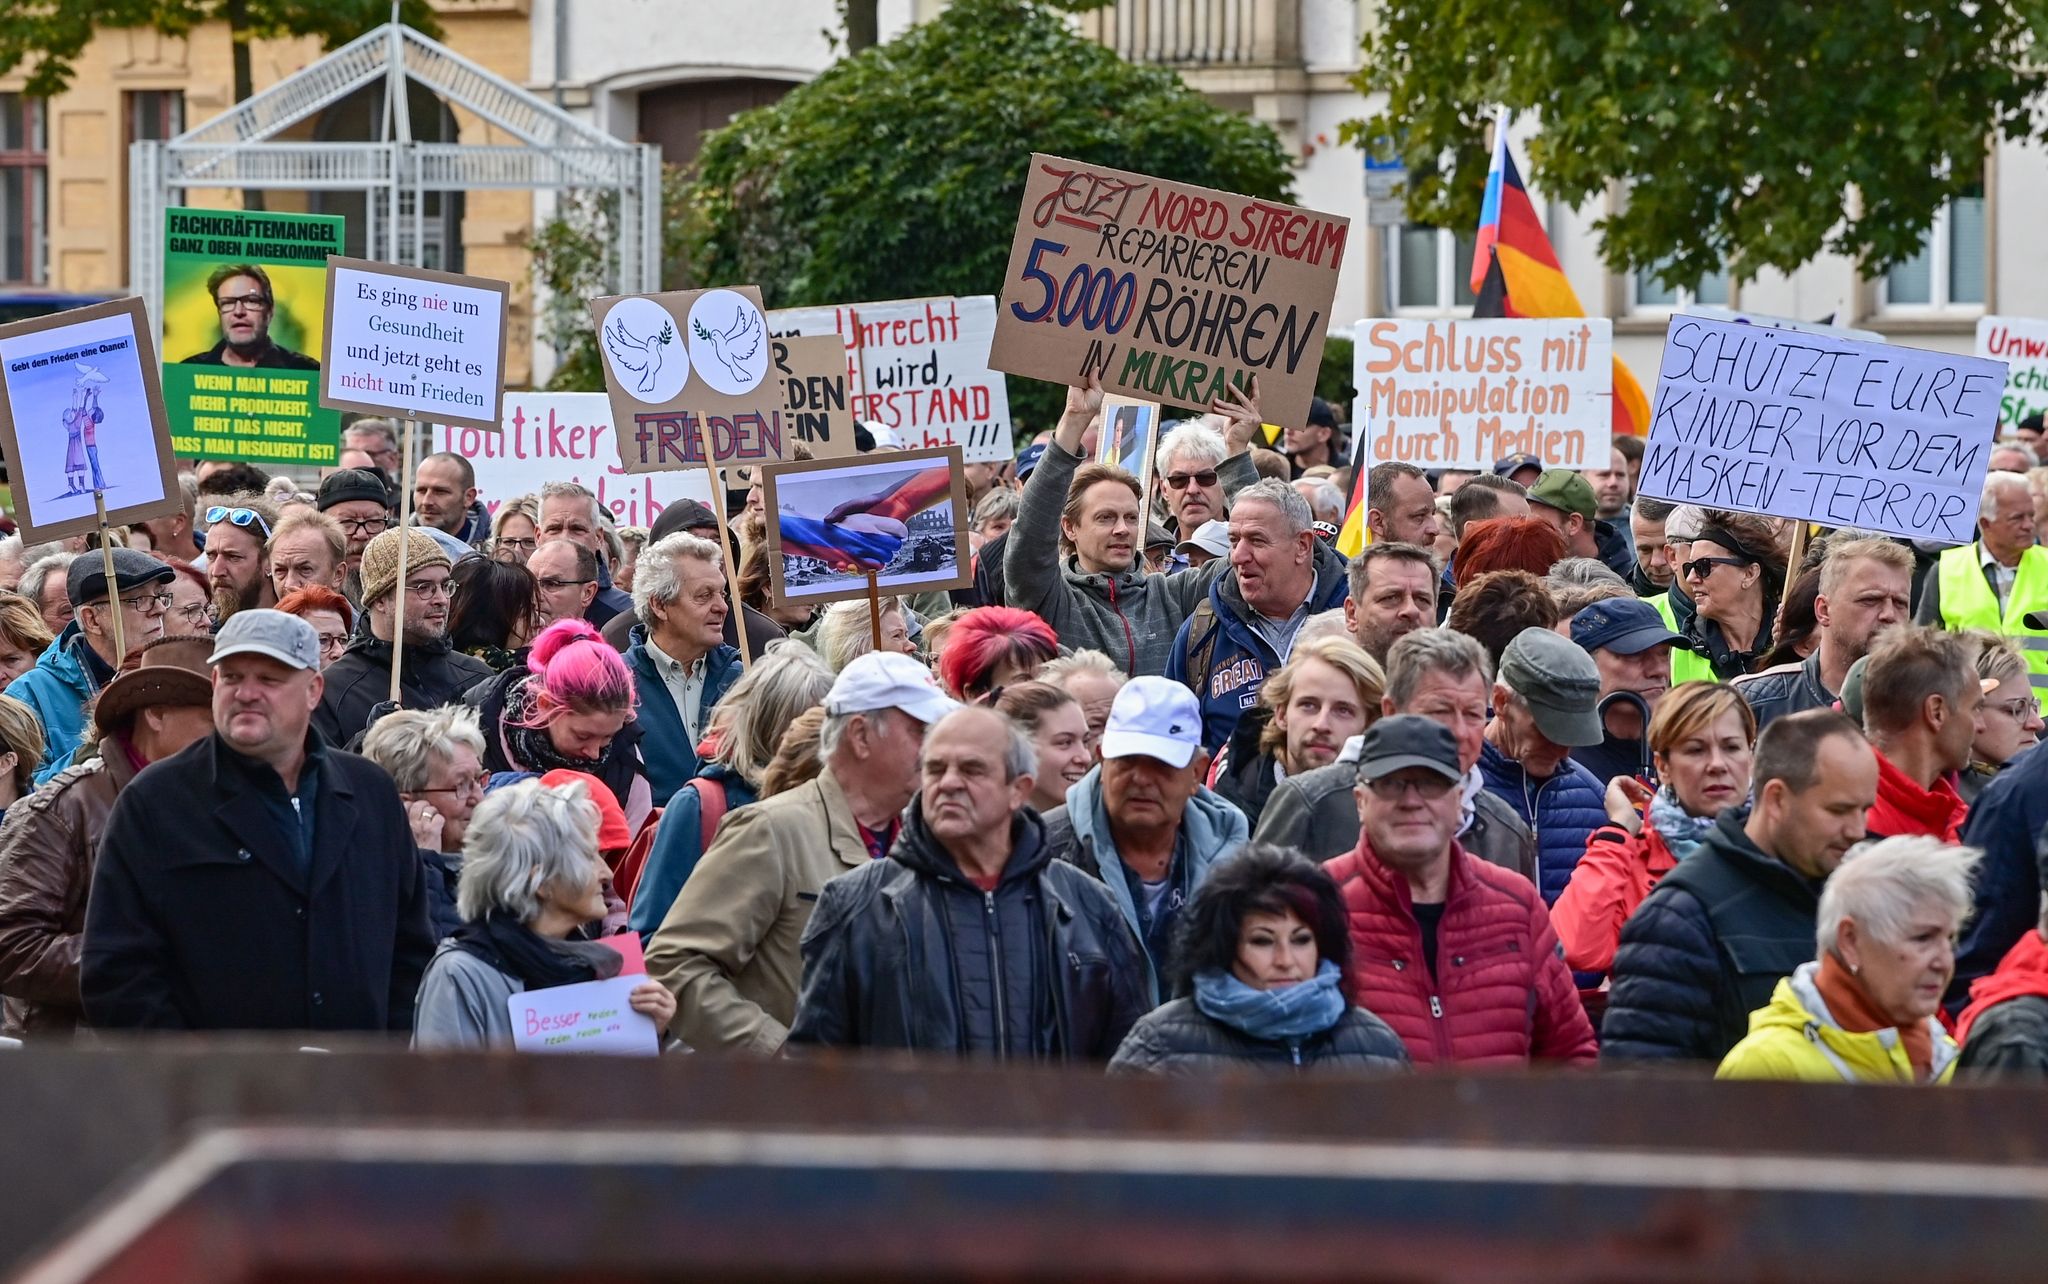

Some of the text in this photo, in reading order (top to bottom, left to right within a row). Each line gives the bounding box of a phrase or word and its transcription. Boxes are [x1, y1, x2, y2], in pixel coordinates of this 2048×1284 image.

[170, 215, 336, 242] FACHKRÄFTEMANGEL
[1032, 163, 1347, 270] JETZT NORD STREAM
[170, 238, 203, 254] GANZ
[208, 240, 242, 256] OBEN
[1097, 223, 1270, 295] REPARIEREN
[357, 282, 479, 316] Es ging nie um
[369, 314, 464, 344] Gesundheit
[836, 302, 960, 350] Unrecht
[1133, 278, 1320, 375] RÖHREN
[1988, 326, 2048, 358] Unw
[11, 340, 128, 372] Gebt dem Frieden eine Chance!
[347, 344, 482, 376] und jetzt geht es
[1366, 321, 1591, 374] Schluss mit
[194, 374, 309, 396] WENN MAN NICHT
[876, 349, 953, 390] wird,
[1079, 339, 1256, 405] IN MUKRAN
[1663, 322, 1994, 419] SCHÜTZT EURE
[341, 372, 484, 406] nicht um Frieden
[1370, 376, 1570, 434] Manipulation
[190, 395, 312, 418] MEHR PRODUZIERT,
[234, 418, 260, 436] DAS
[264, 420, 307, 438] NICHT,
[634, 408, 782, 464] FRIEDEN
[1374, 415, 1585, 465] durch Medien
[204, 438, 234, 454] MAN
[238, 440, 306, 459] INSOLVENT
[308, 444, 334, 460] IST!
[1818, 413, 1884, 470] VOR
[1888, 430, 1980, 486] DEM
[526, 1008, 580, 1036] Besser
